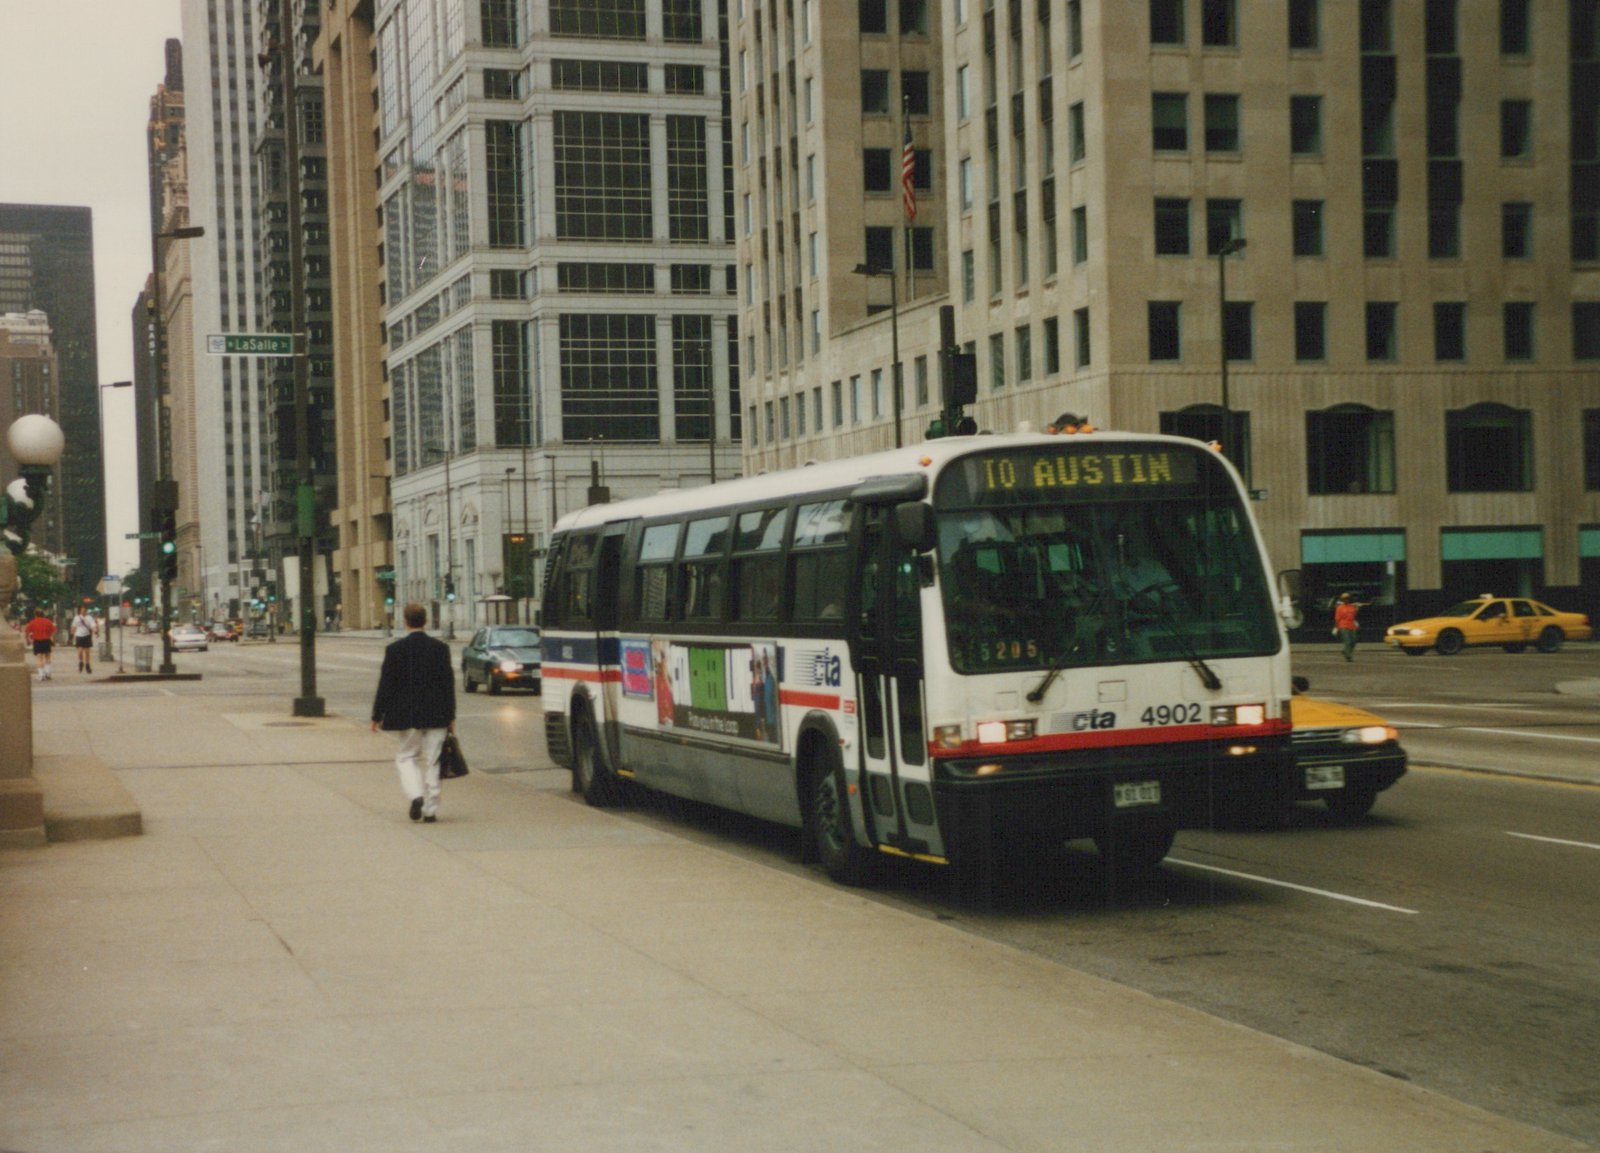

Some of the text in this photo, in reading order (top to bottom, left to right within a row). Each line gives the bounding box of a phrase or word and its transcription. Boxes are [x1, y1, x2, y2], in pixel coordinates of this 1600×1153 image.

[235, 338, 278, 351] LaSalle
[984, 453, 1172, 488] TO AUSTIN
[814, 647, 841, 687] cta
[1072, 703, 1202, 731] cta 4902
